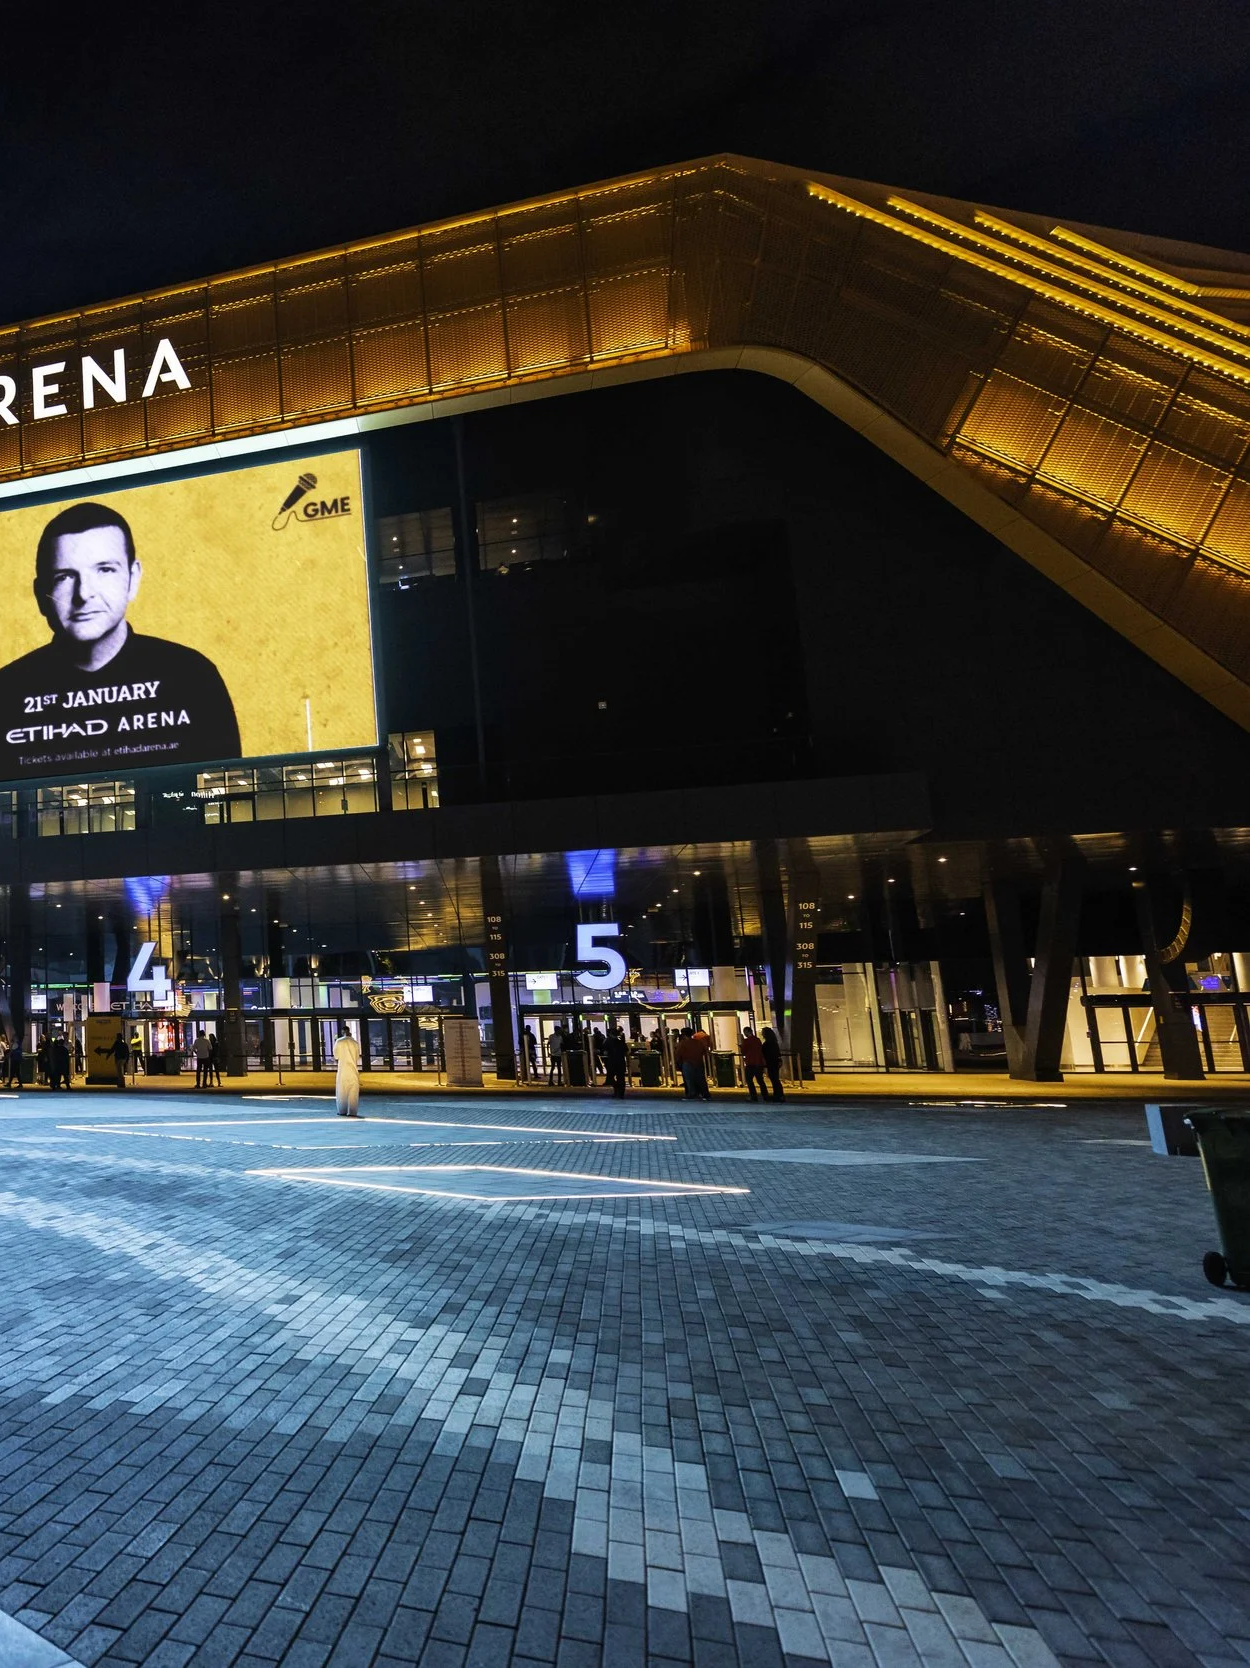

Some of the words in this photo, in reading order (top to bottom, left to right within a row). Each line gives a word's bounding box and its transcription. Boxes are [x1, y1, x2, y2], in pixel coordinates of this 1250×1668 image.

[303, 496, 350, 518] GME
[24, 693, 58, 713] 21ST
[62, 681, 160, 710] JANUARY
[6, 719, 108, 745] ETIHAD
[117, 709, 191, 732] ARENA
[18, 751, 53, 766] Tickets
[55, 747, 99, 763] available
[101, 748, 111, 758] at
[113, 739, 180, 756] etihadarena.ae
[798, 902, 816, 910] 108
[490, 933, 502, 941] 115
[796, 942, 815, 951] 308
[489, 952, 505, 960] 308
[575, 922, 629, 991] 5
[127, 941, 174, 1002] 4
